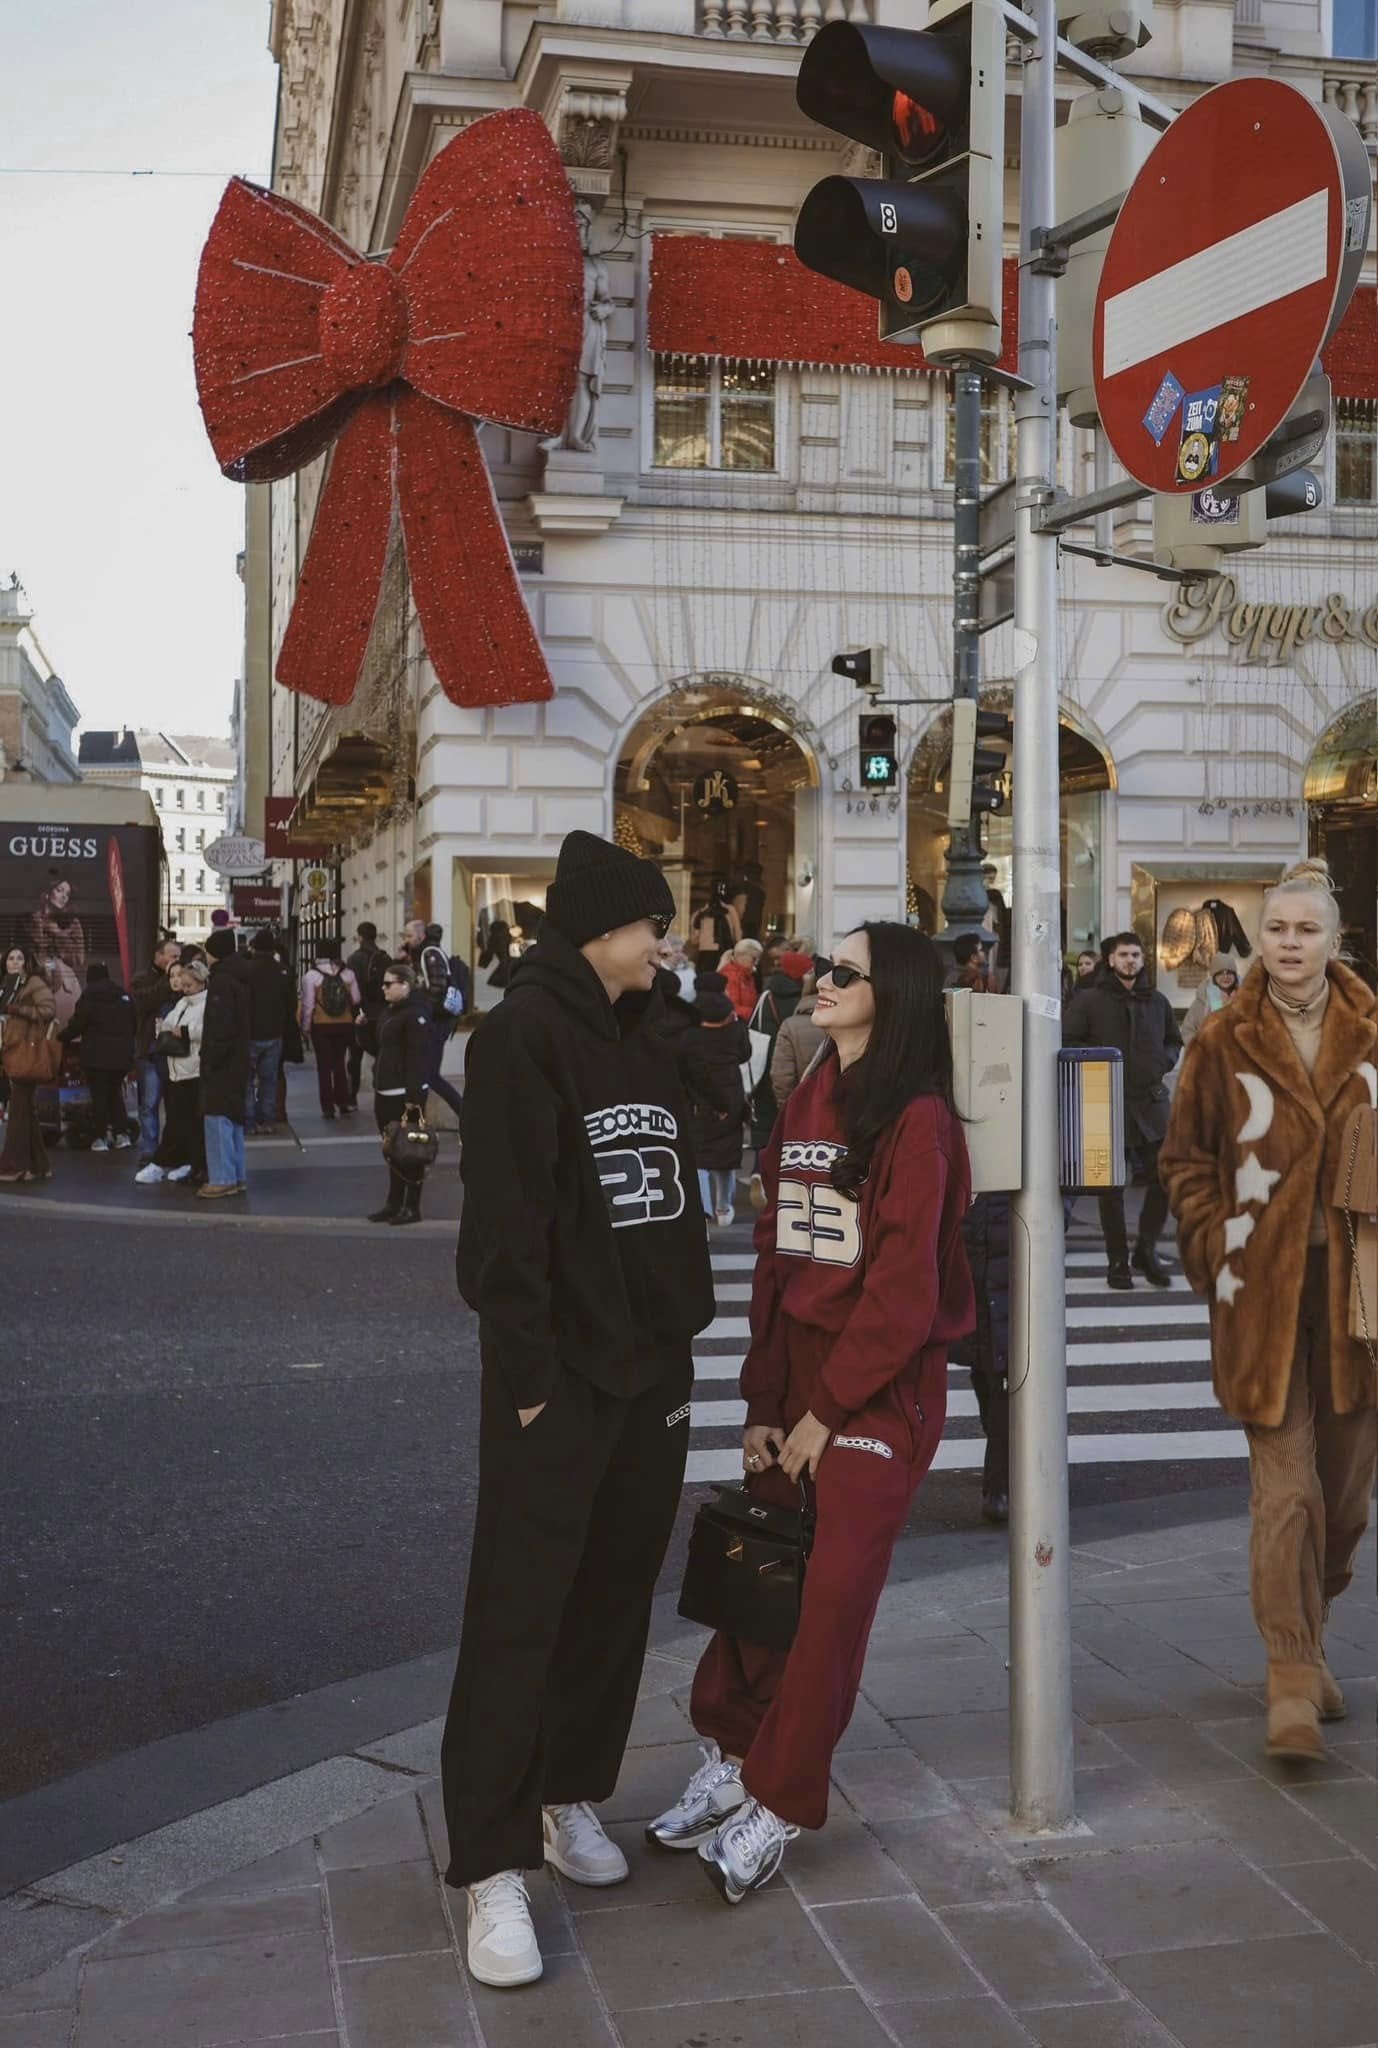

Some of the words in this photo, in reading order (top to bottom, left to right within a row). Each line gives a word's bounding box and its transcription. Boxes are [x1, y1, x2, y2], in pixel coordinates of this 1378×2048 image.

[883, 205, 896, 231] 8
[1187, 400, 1203, 418] ZEIT
[1305, 484, 1316, 504] 5
[8, 836, 97, 858] GUESS
[207, 855, 265, 865] SUZANN
[593, 1146, 685, 1229] 23
[775, 1178, 863, 1268] 23
